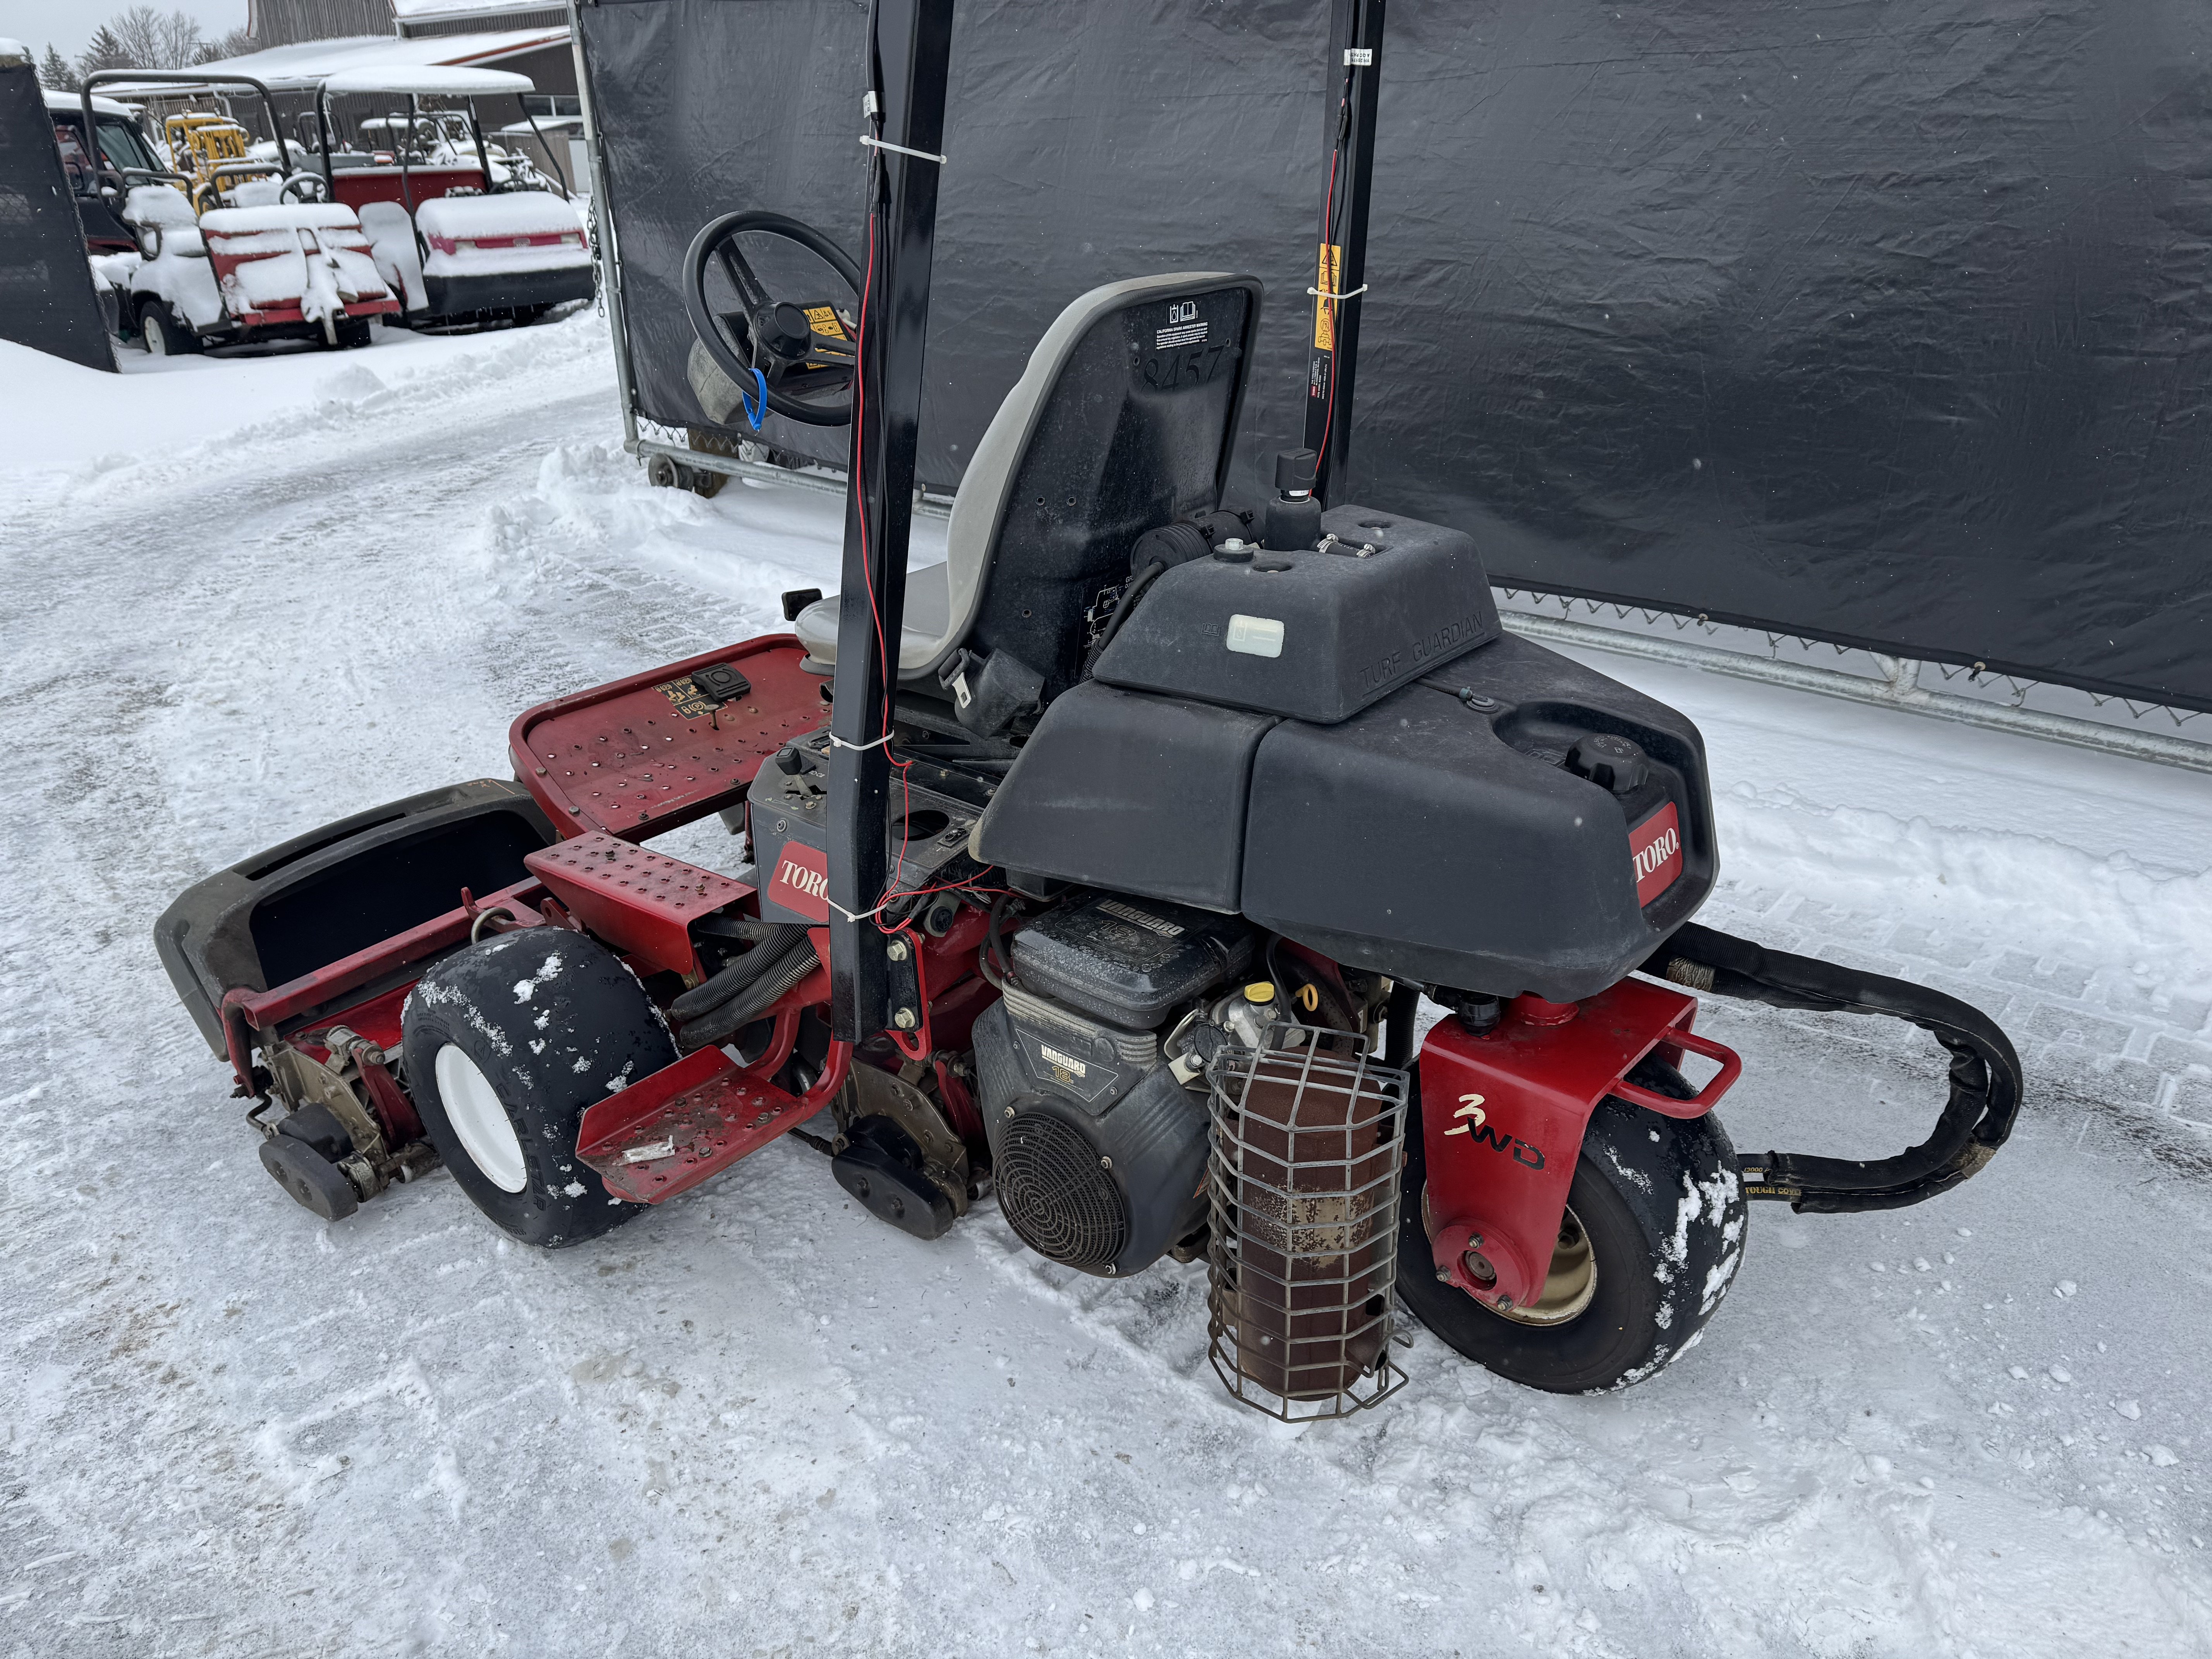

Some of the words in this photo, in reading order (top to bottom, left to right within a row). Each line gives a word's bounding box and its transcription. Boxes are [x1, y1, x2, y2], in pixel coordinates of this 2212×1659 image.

[1360, 651, 1401, 688] TURF
[1412, 611, 1484, 662] GUARDIAN
[1633, 828, 1676, 883] TORO
[1098, 899, 1185, 936] VANGUARD
[1101, 920, 1137, 938] 18
[1041, 1044, 1086, 1075] VANGUARD
[1052, 1066, 1070, 1083] 18
[1444, 1094, 1545, 1170] 3WD
